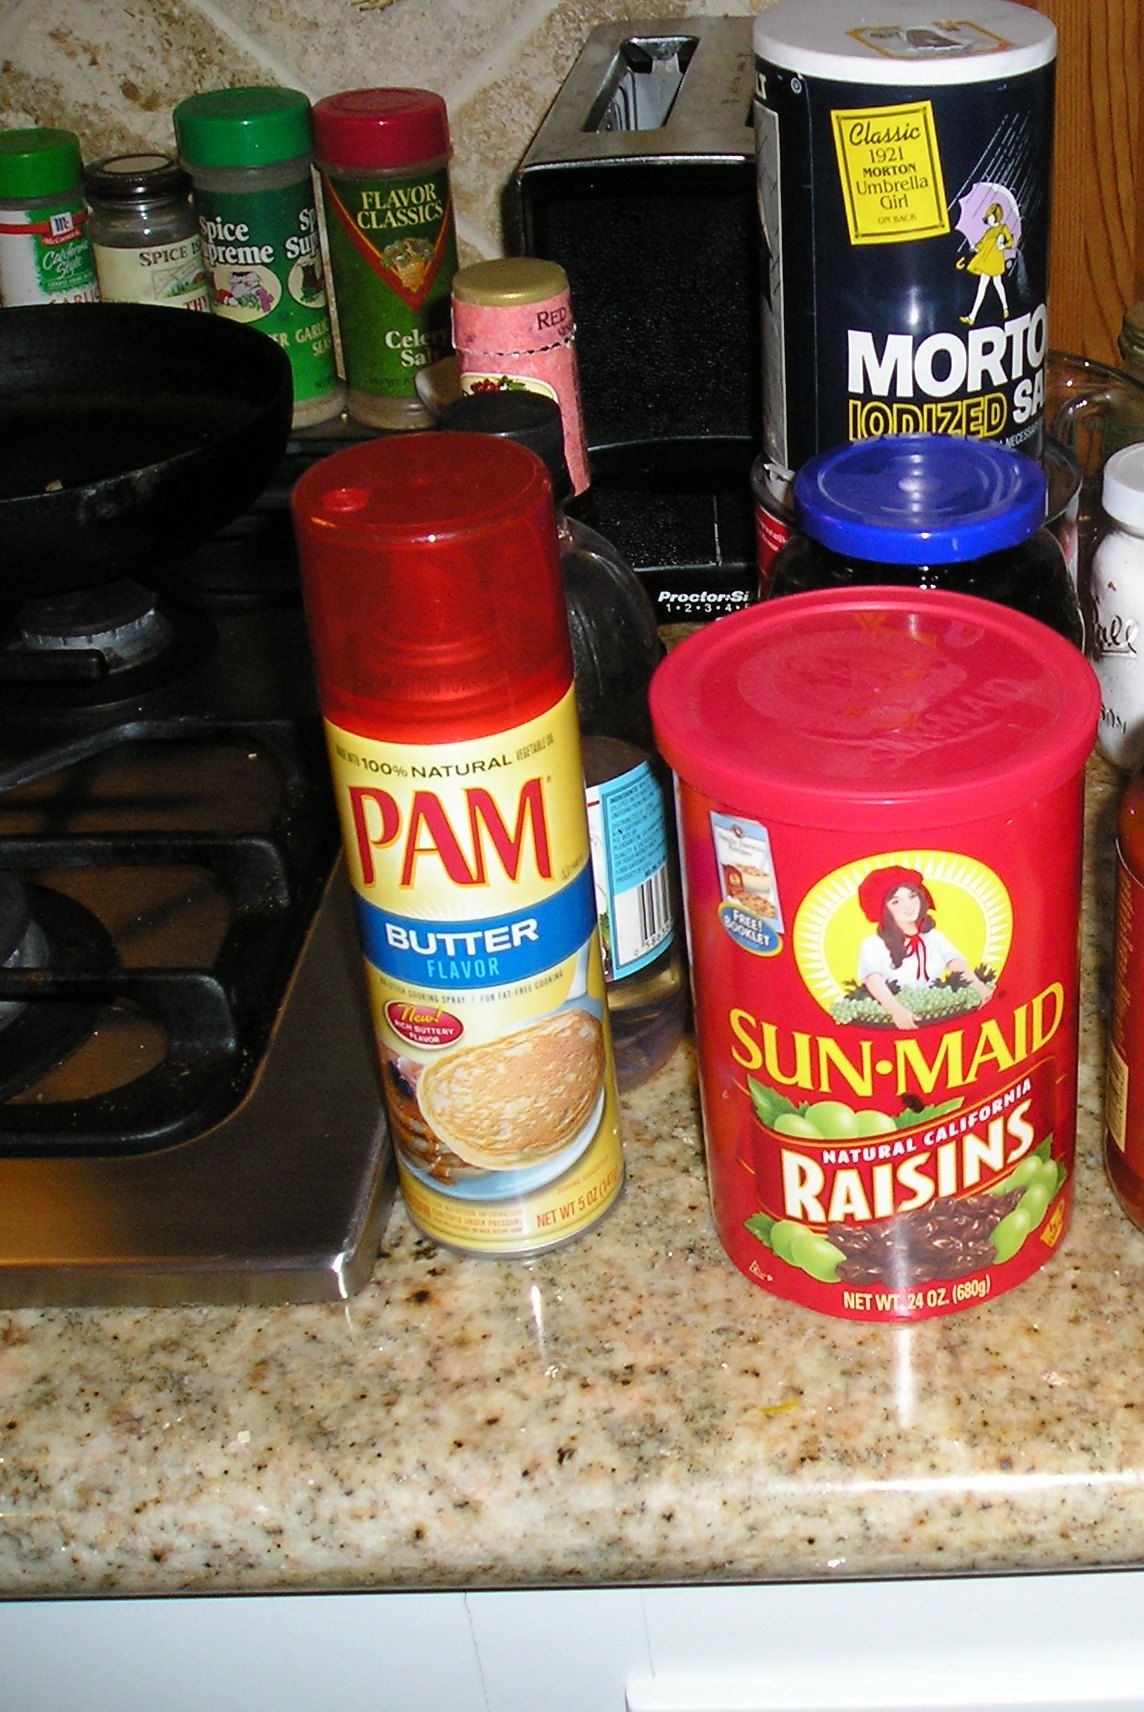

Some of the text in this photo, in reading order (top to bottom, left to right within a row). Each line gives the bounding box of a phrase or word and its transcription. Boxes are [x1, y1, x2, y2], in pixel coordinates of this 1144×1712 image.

[850, 122, 920, 146] Classic
[870, 146, 904, 163] 1921
[863, 162, 917, 178] MORTON
[361, 183, 437, 209] FLAVOR
[856, 176, 929, 195] Umbrella
[880, 194, 909, 210] Girl
[357, 200, 443, 229] CLASSICS
[878, 213, 917, 224] ON BACK
[138, 246, 188, 267] SPICE
[203, 243, 274, 265] preme
[537, 306, 568, 330] RED
[848, 303, 1046, 397] MORTO
[1013, 369, 1044, 424] SA
[361, 757, 408, 777] 100%
[411, 754, 512, 778] NATURAL
[345, 776, 553, 890] PAM
[724, 914, 770, 946] BOOKLET
[733, 909, 762, 932] FREE!
[385, 917, 539, 956] BUTTER
[427, 956, 500, 980] FLAVOR
[399, 1003, 442, 1024] New!
[409, 1031, 440, 1044] FLAVOR
[414, 1024, 455, 1036] BUTTERY
[822, 1078, 1032, 1165] NATURAL CALIFORNIA
[781, 1099, 1034, 1222] RAISINS
[537, 1209, 557, 1228] NET
[560, 1204, 575, 1221] WT
[578, 1196, 586, 1211] 5
[587, 1187, 600, 1206] OZ
[843, 1291, 872, 1310] NET
[907, 1291, 925, 1309] 24
[927, 1288, 949, 1307] OZ.
[952, 1274, 992, 1306] (680g)
